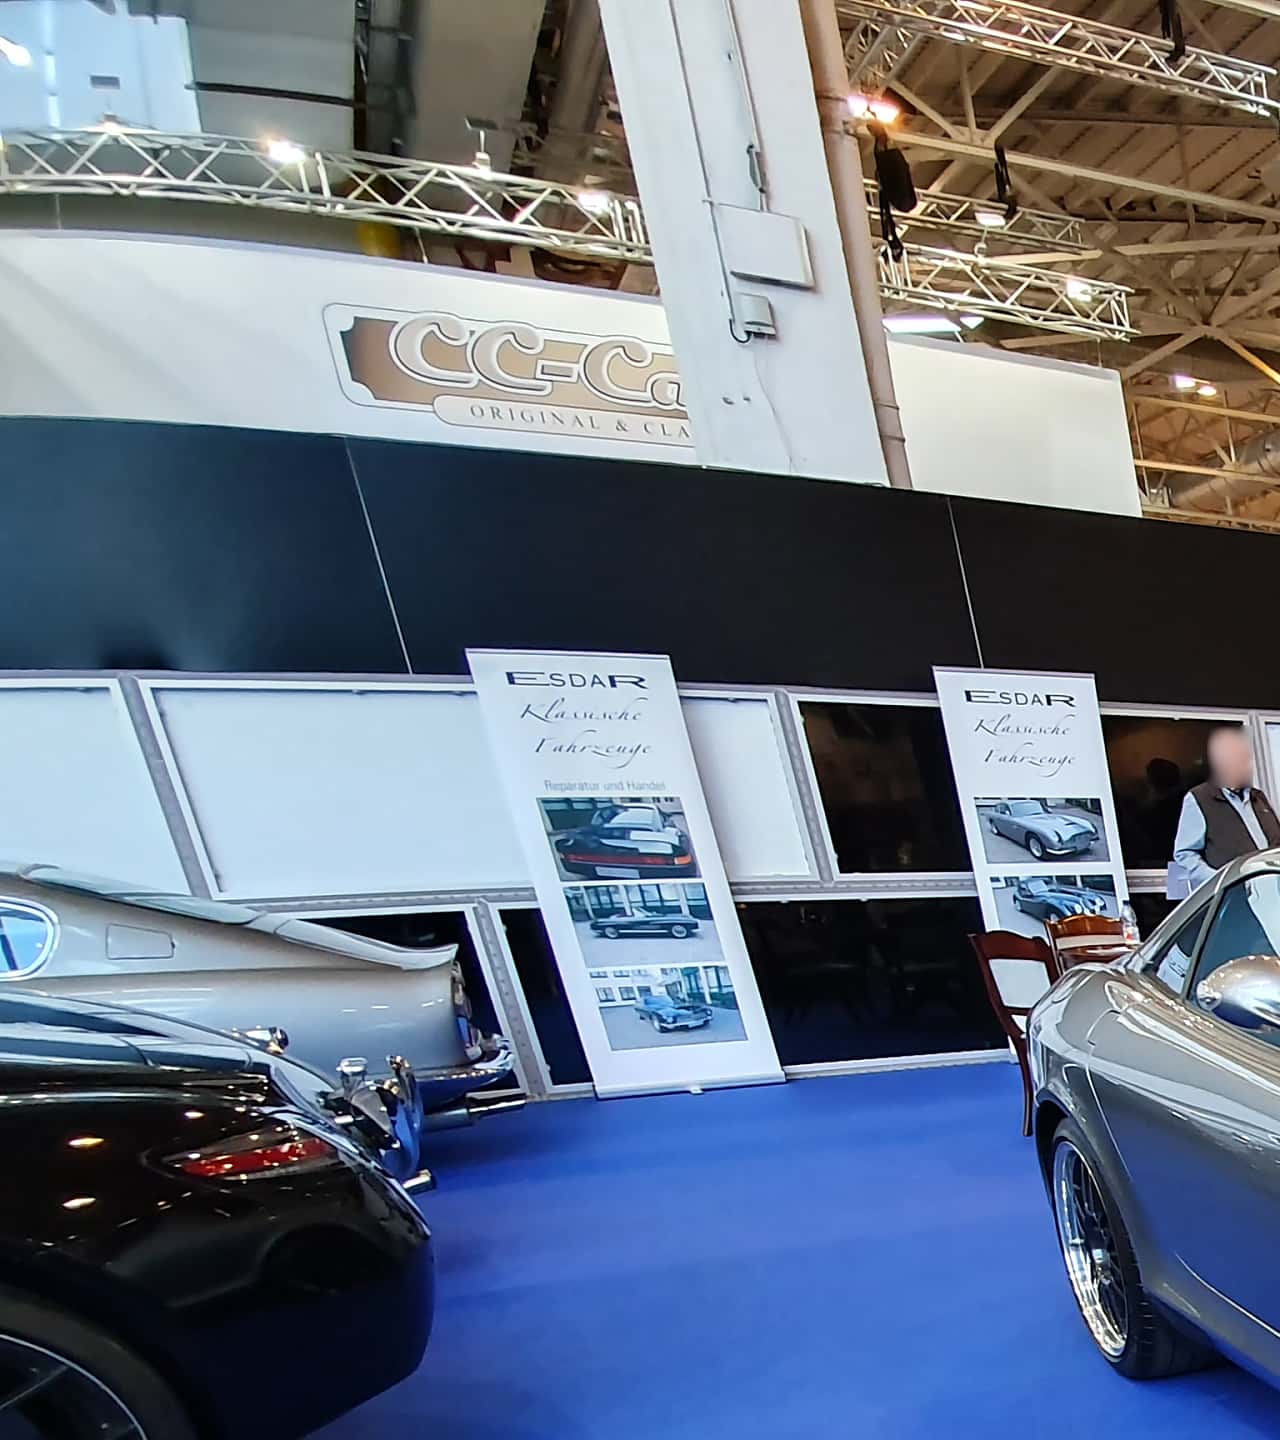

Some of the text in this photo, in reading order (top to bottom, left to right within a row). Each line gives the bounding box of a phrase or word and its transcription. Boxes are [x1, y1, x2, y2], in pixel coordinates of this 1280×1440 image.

[470, 403, 601, 431] ORIGINAL
[614, 419, 629, 433] &
[505, 671, 648, 690] ESDAR
[520, 696, 648, 724] Klassische
[964, 689, 1077, 708] ESDAR
[973, 713, 1076, 737] Klassische
[535, 728, 651, 770] Fahrzeuge
[984, 741, 1076, 778] Fahrzeuge
